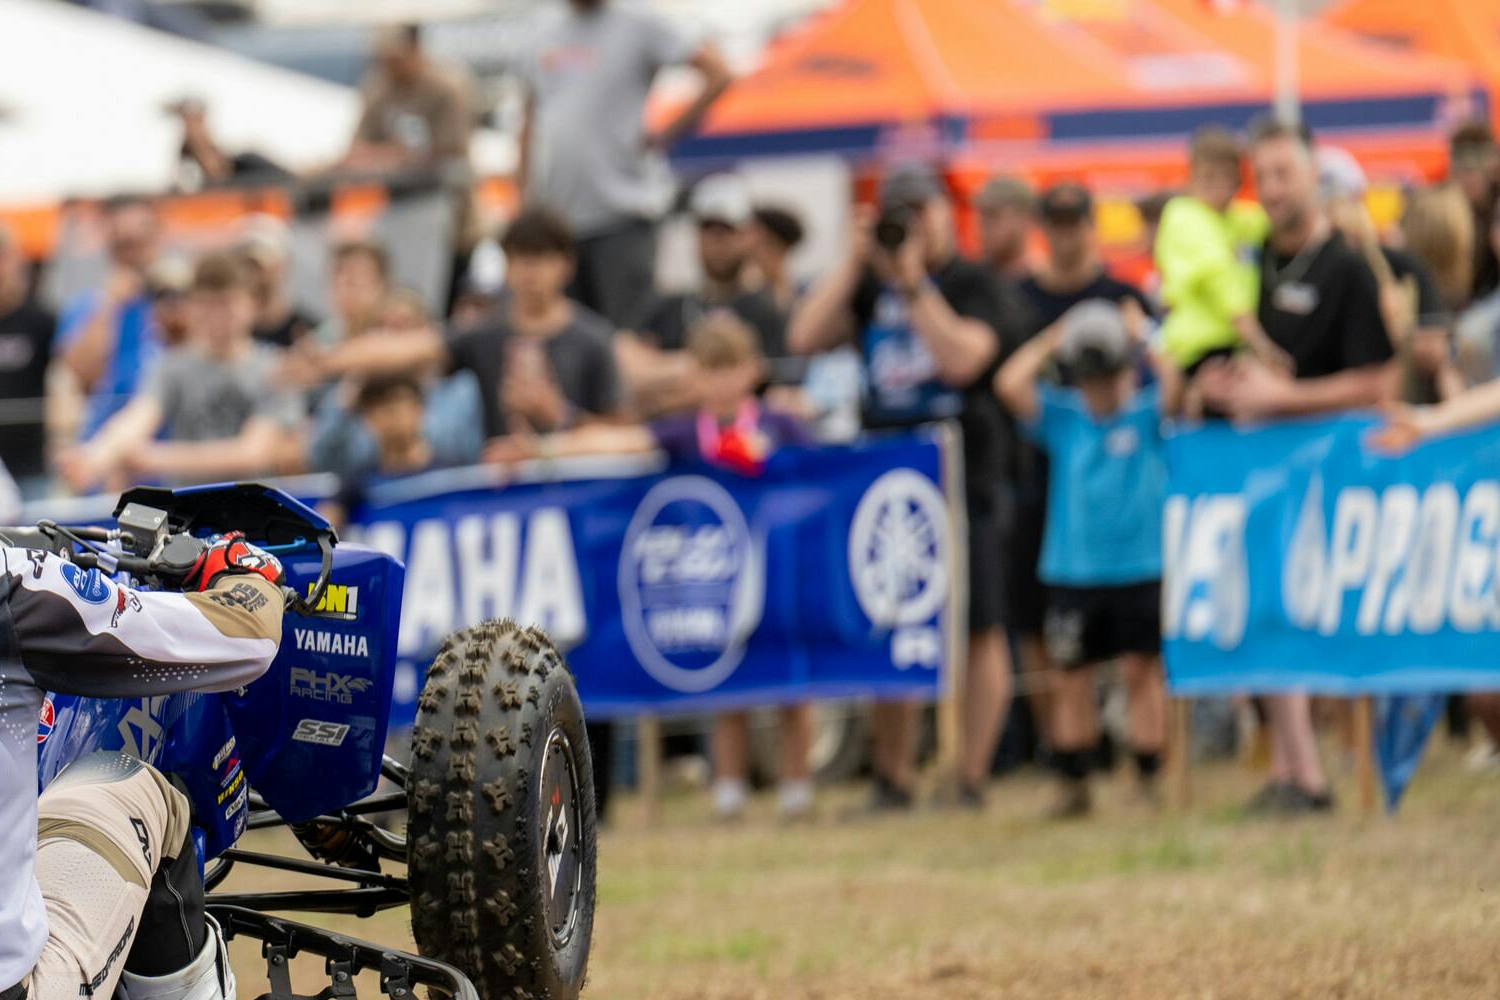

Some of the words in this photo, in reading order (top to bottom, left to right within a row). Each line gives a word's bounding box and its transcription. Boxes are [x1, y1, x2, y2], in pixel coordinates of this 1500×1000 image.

[294, 628, 369, 657] YAMAHA
[290, 667, 353, 696] PHX
[290, 686, 353, 704] RACING
[296, 720, 348, 740] SSI
